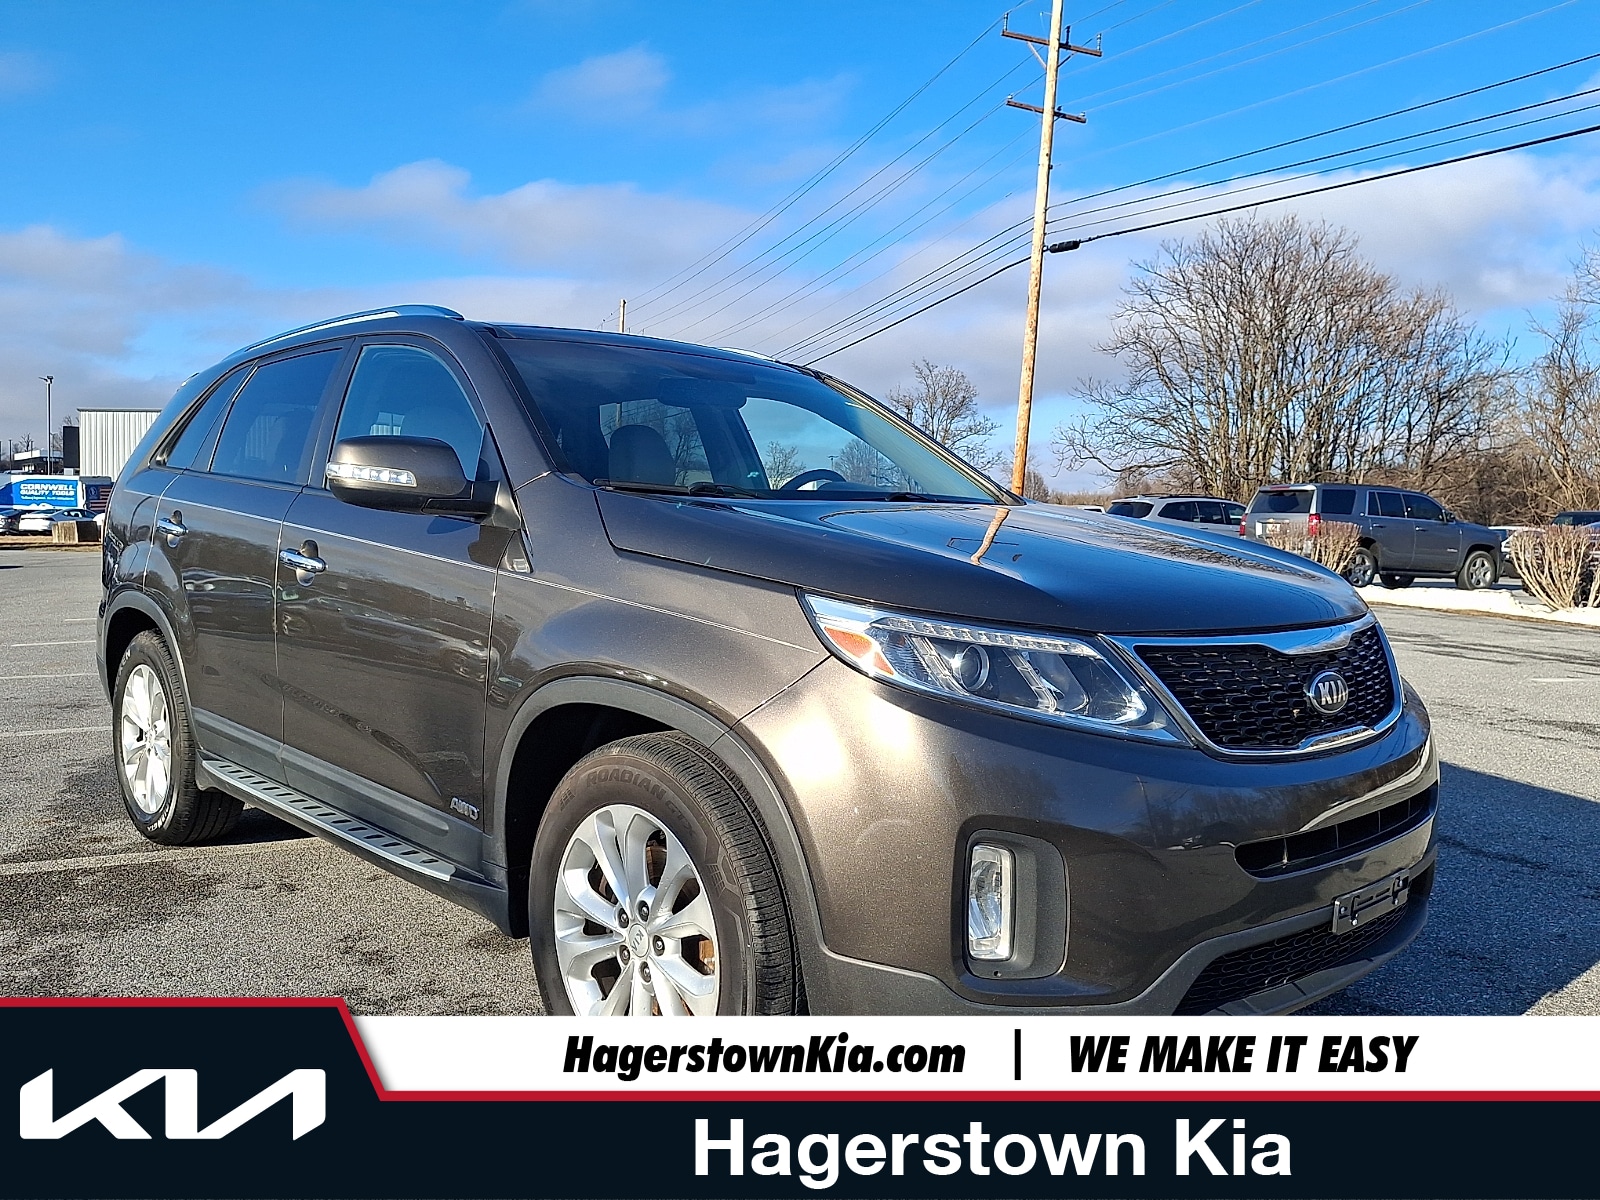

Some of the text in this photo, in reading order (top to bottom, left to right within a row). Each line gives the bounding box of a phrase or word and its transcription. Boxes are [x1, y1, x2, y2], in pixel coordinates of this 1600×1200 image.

[20, 483, 76, 491] CORNWELL
[1317, 680, 1346, 705] KIA
[586, 768, 667, 800] ROADIAN
[450, 797, 480, 820] AWD
[631, 929, 645, 951] KIA
